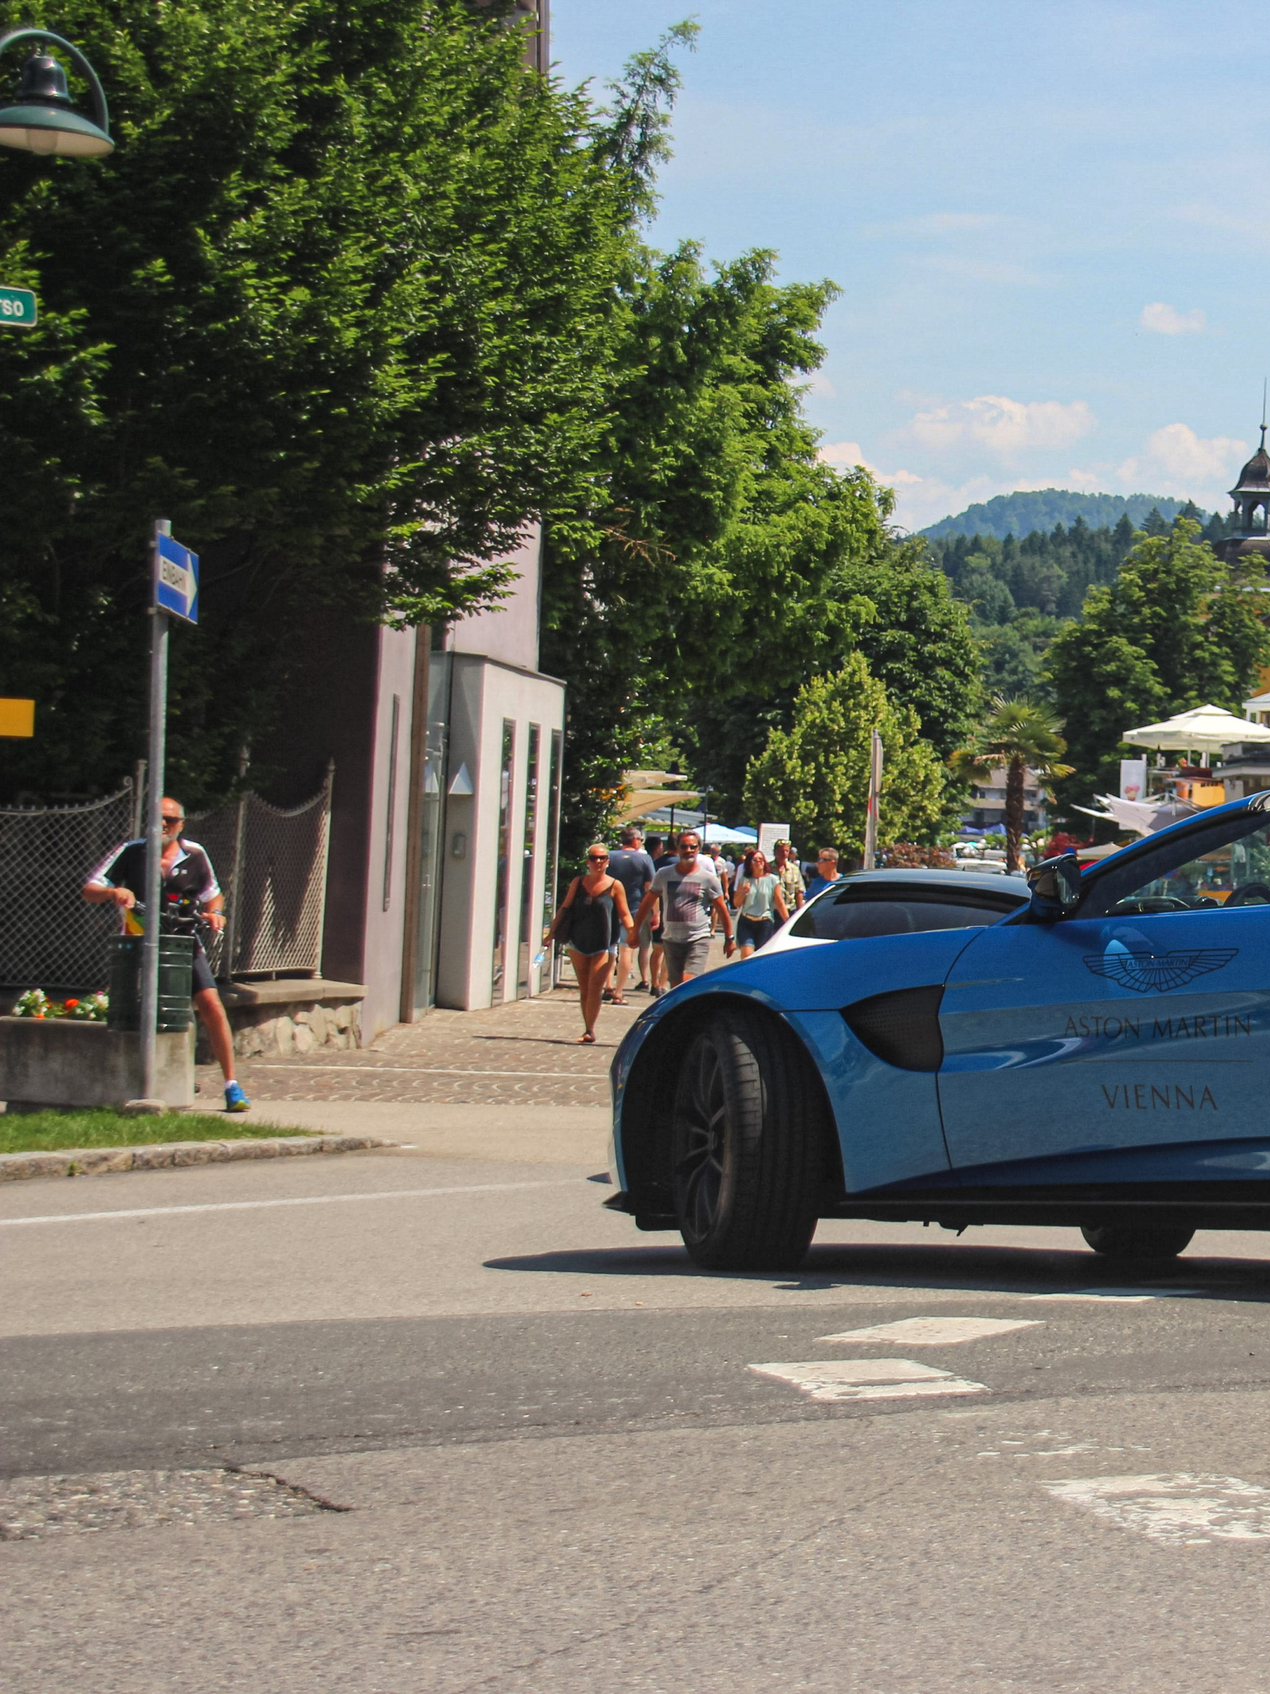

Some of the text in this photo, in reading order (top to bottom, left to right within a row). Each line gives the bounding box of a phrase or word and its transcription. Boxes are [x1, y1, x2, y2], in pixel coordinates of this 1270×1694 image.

[0, 299, 25, 317] so
[1127, 958, 1188, 968] ASTON MARTIN
[1064, 1015, 1252, 1039] ASTON MARTIN
[1101, 1084, 1219, 1111] VIENNA
